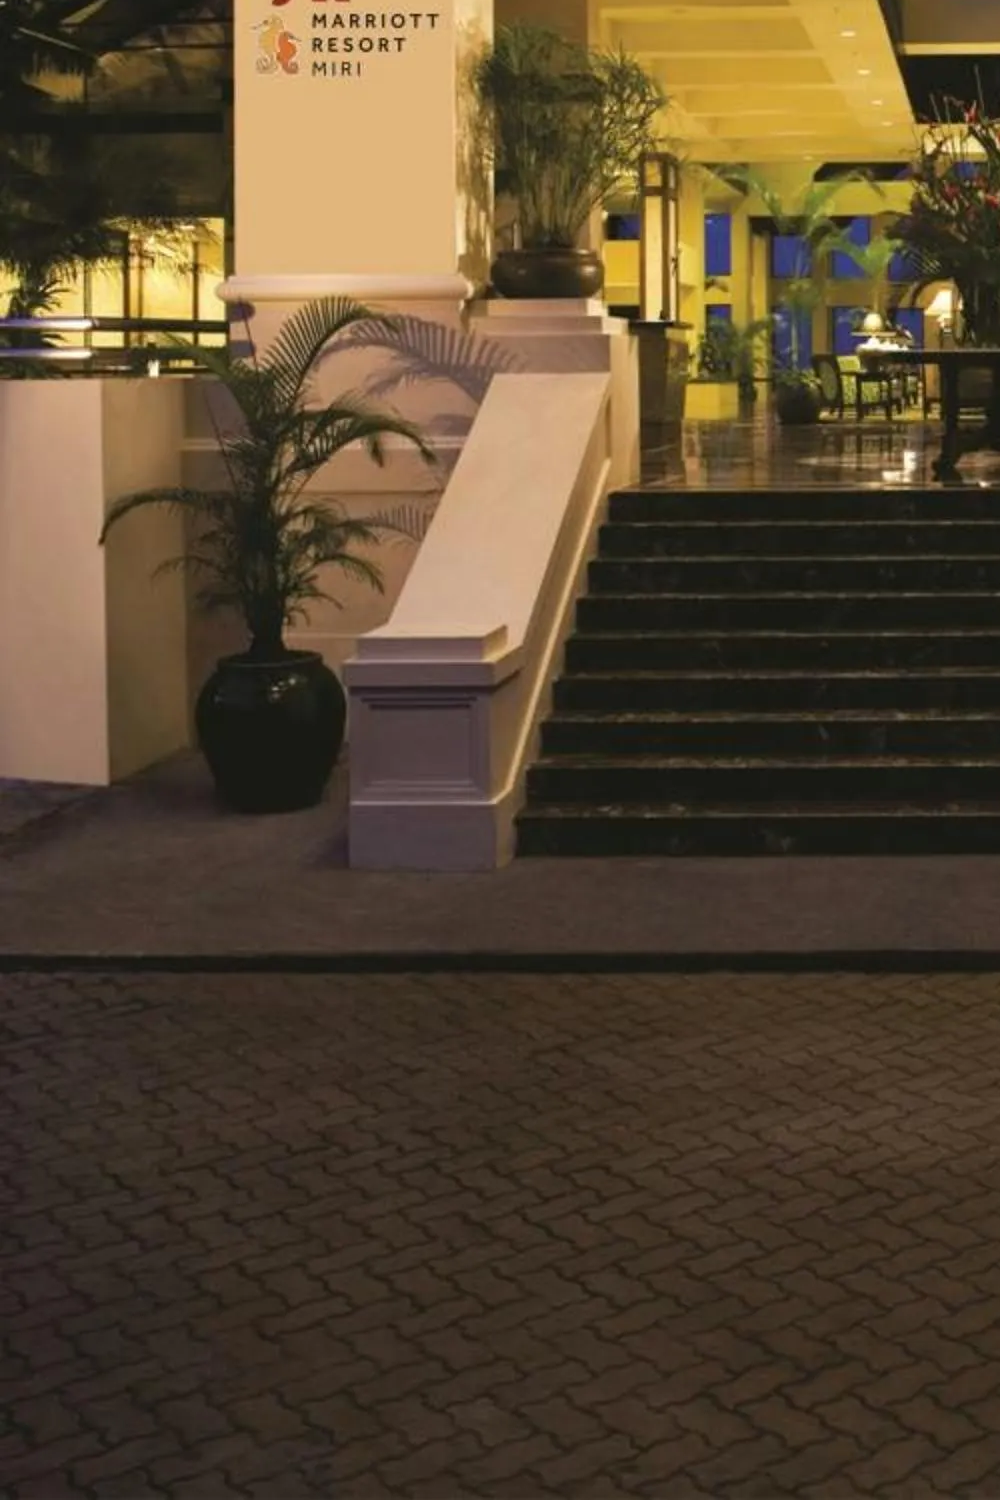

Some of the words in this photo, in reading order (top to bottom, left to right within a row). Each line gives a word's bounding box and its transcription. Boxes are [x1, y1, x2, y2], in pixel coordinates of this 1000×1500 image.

[311, 13, 440, 29] MARRIOTT
[311, 37, 407, 53] RESORT
[311, 61, 362, 77] MIRI
